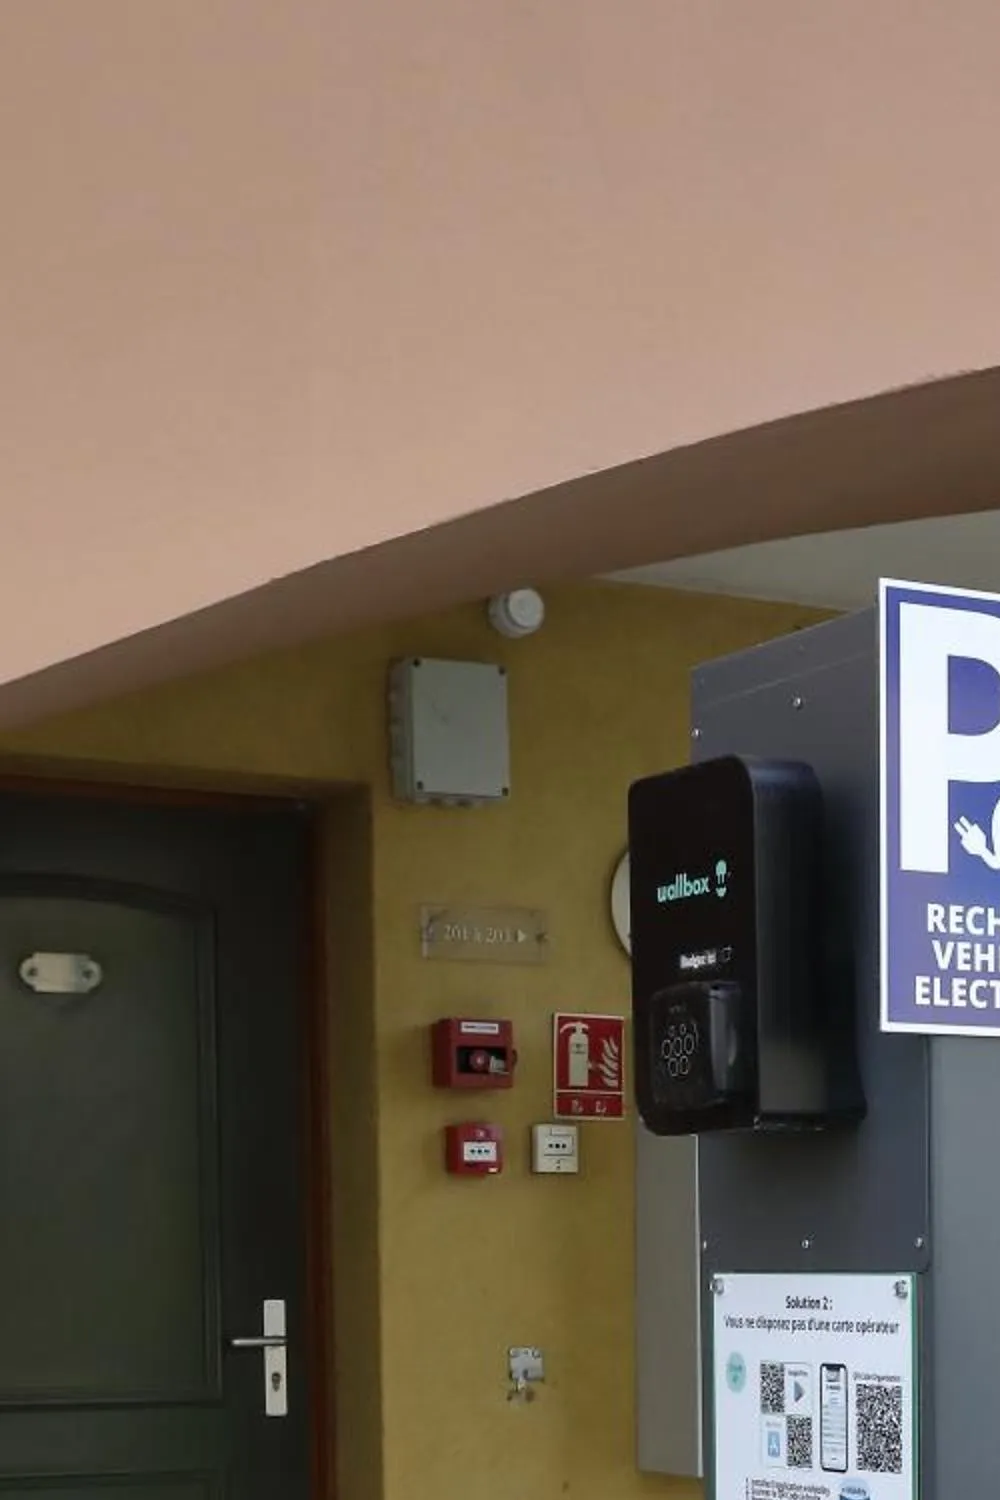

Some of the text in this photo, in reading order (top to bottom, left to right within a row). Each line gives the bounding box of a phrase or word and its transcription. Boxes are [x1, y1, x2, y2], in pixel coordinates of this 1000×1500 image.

[657, 872, 711, 902] wallbox
[785, 1295, 821, 1310] Solution
[724, 1315, 900, 1335] Vous ne disposez pas d'une carte opérateur
